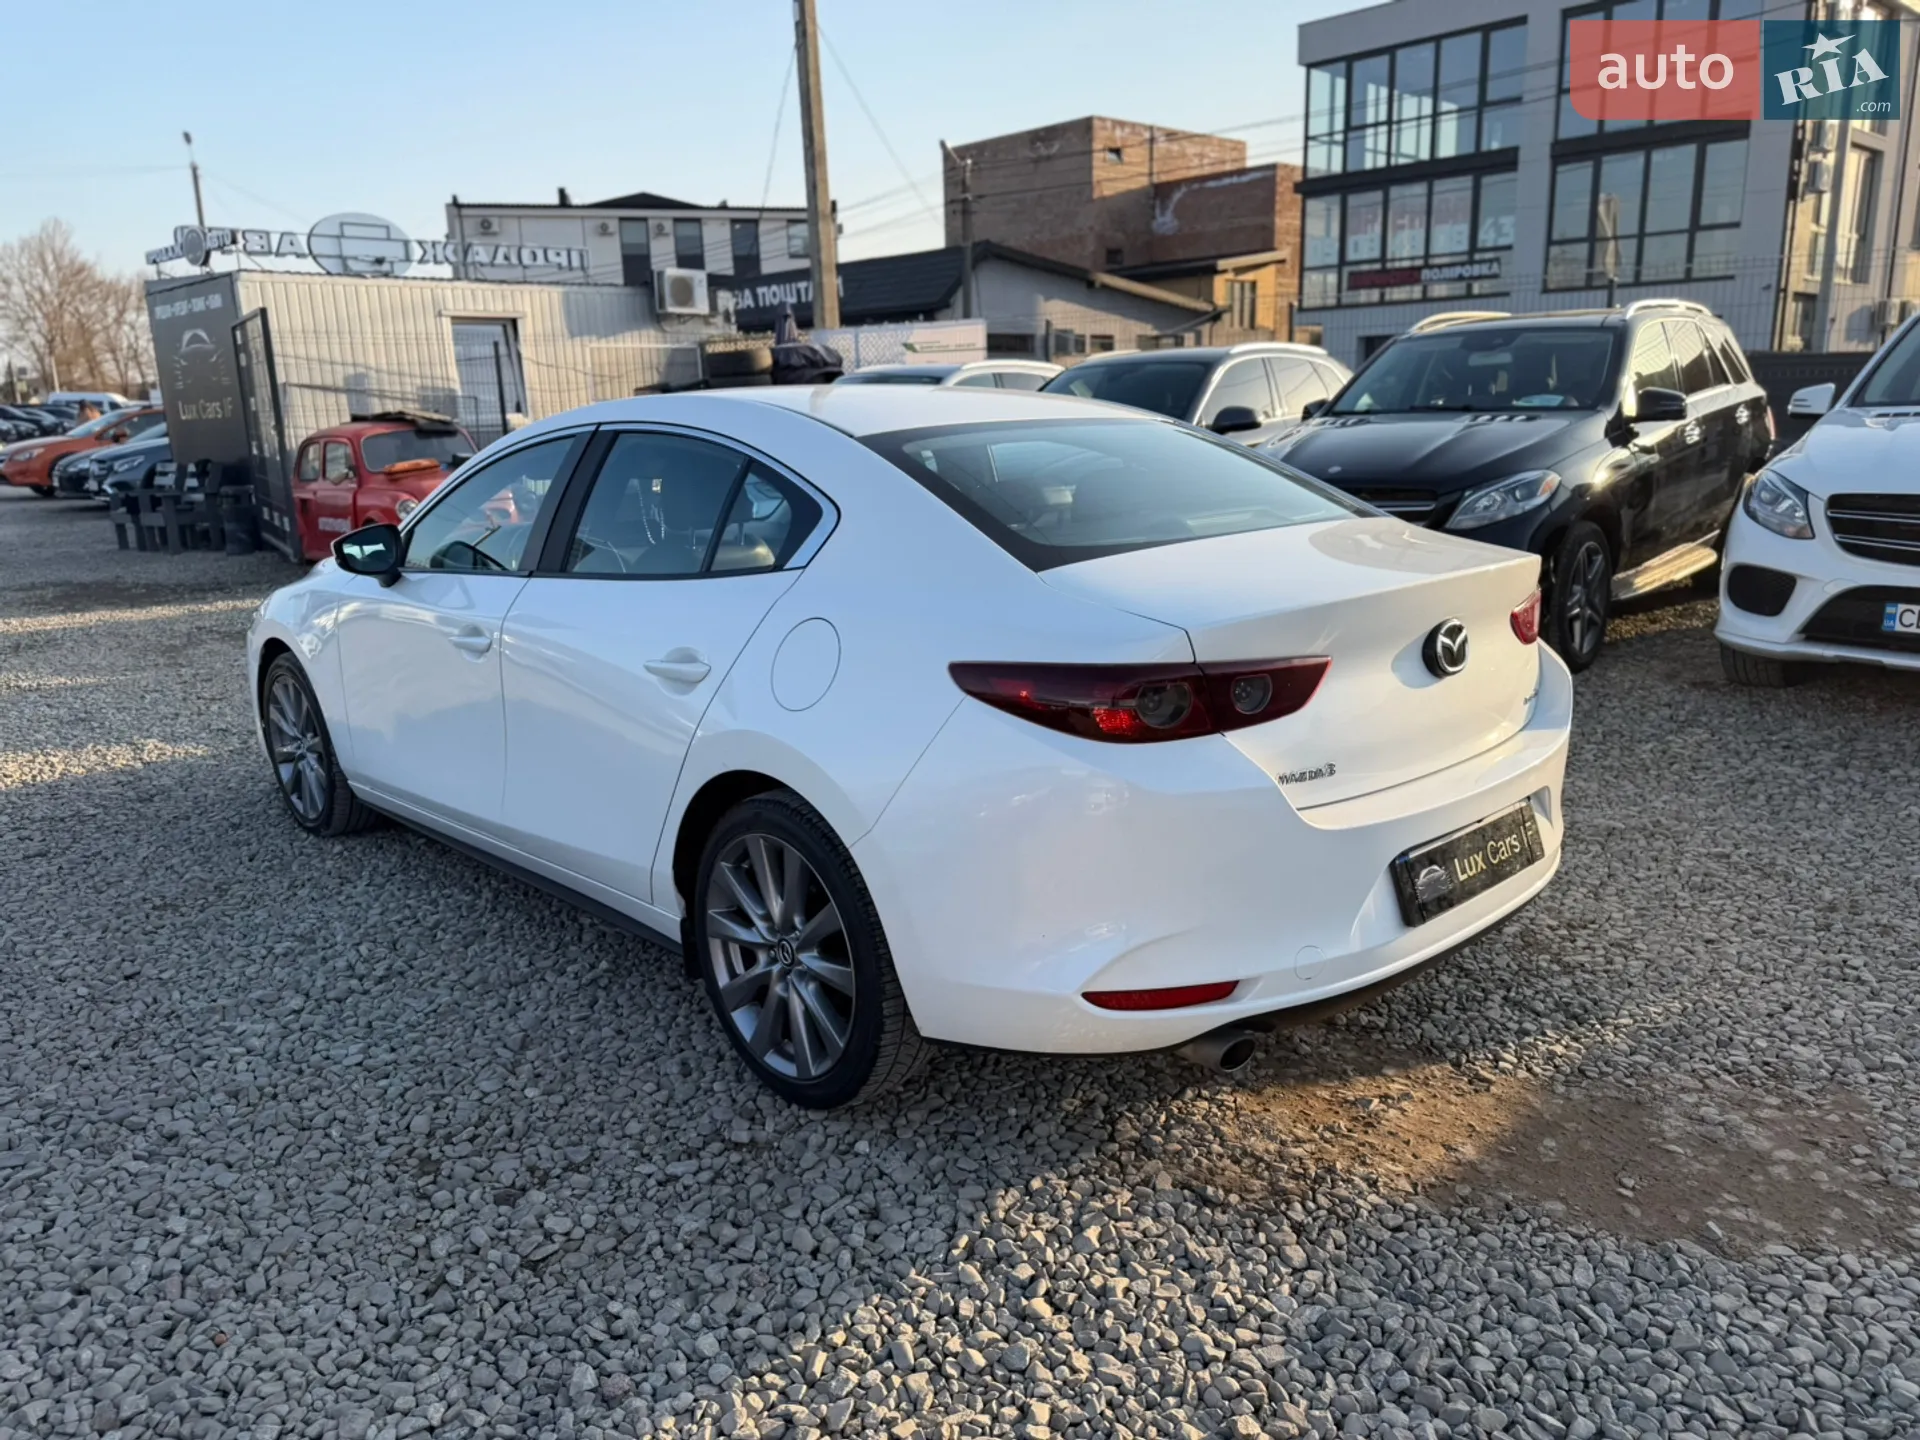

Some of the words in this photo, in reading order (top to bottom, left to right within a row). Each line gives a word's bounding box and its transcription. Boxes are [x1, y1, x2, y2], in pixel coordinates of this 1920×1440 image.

[1420, 261, 1500, 281] ПОЛІРОВКА
[1454, 850, 1486, 882] Lux
[1487, 833, 1520, 864] Cars
